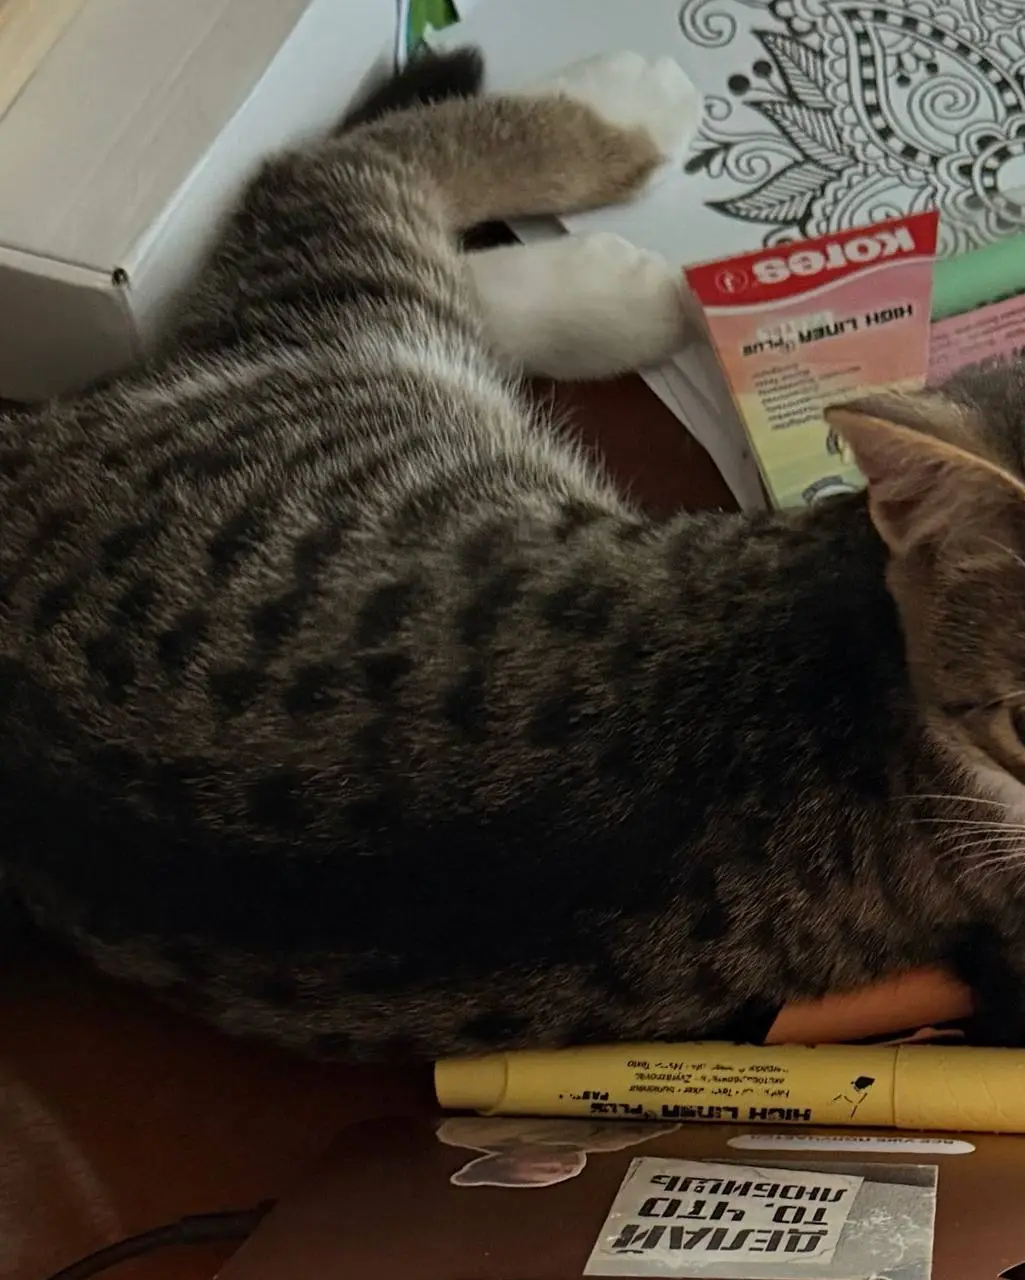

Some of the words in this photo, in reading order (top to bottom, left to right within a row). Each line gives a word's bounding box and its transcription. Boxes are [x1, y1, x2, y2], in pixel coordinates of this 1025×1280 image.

[752, 226, 916, 286] Kores
[865, 304, 914, 326] HIGH
[798, 317, 858, 345] LINER
[742, 337, 785, 357] PLUS
[748, 1106, 813, 1122] HIGH
[648, 1174, 849, 1204] ЛЮБИШЬ
[636, 1196, 746, 1223] ЧТО
[610, 1223, 830, 1256] ДЕЛАЙ
